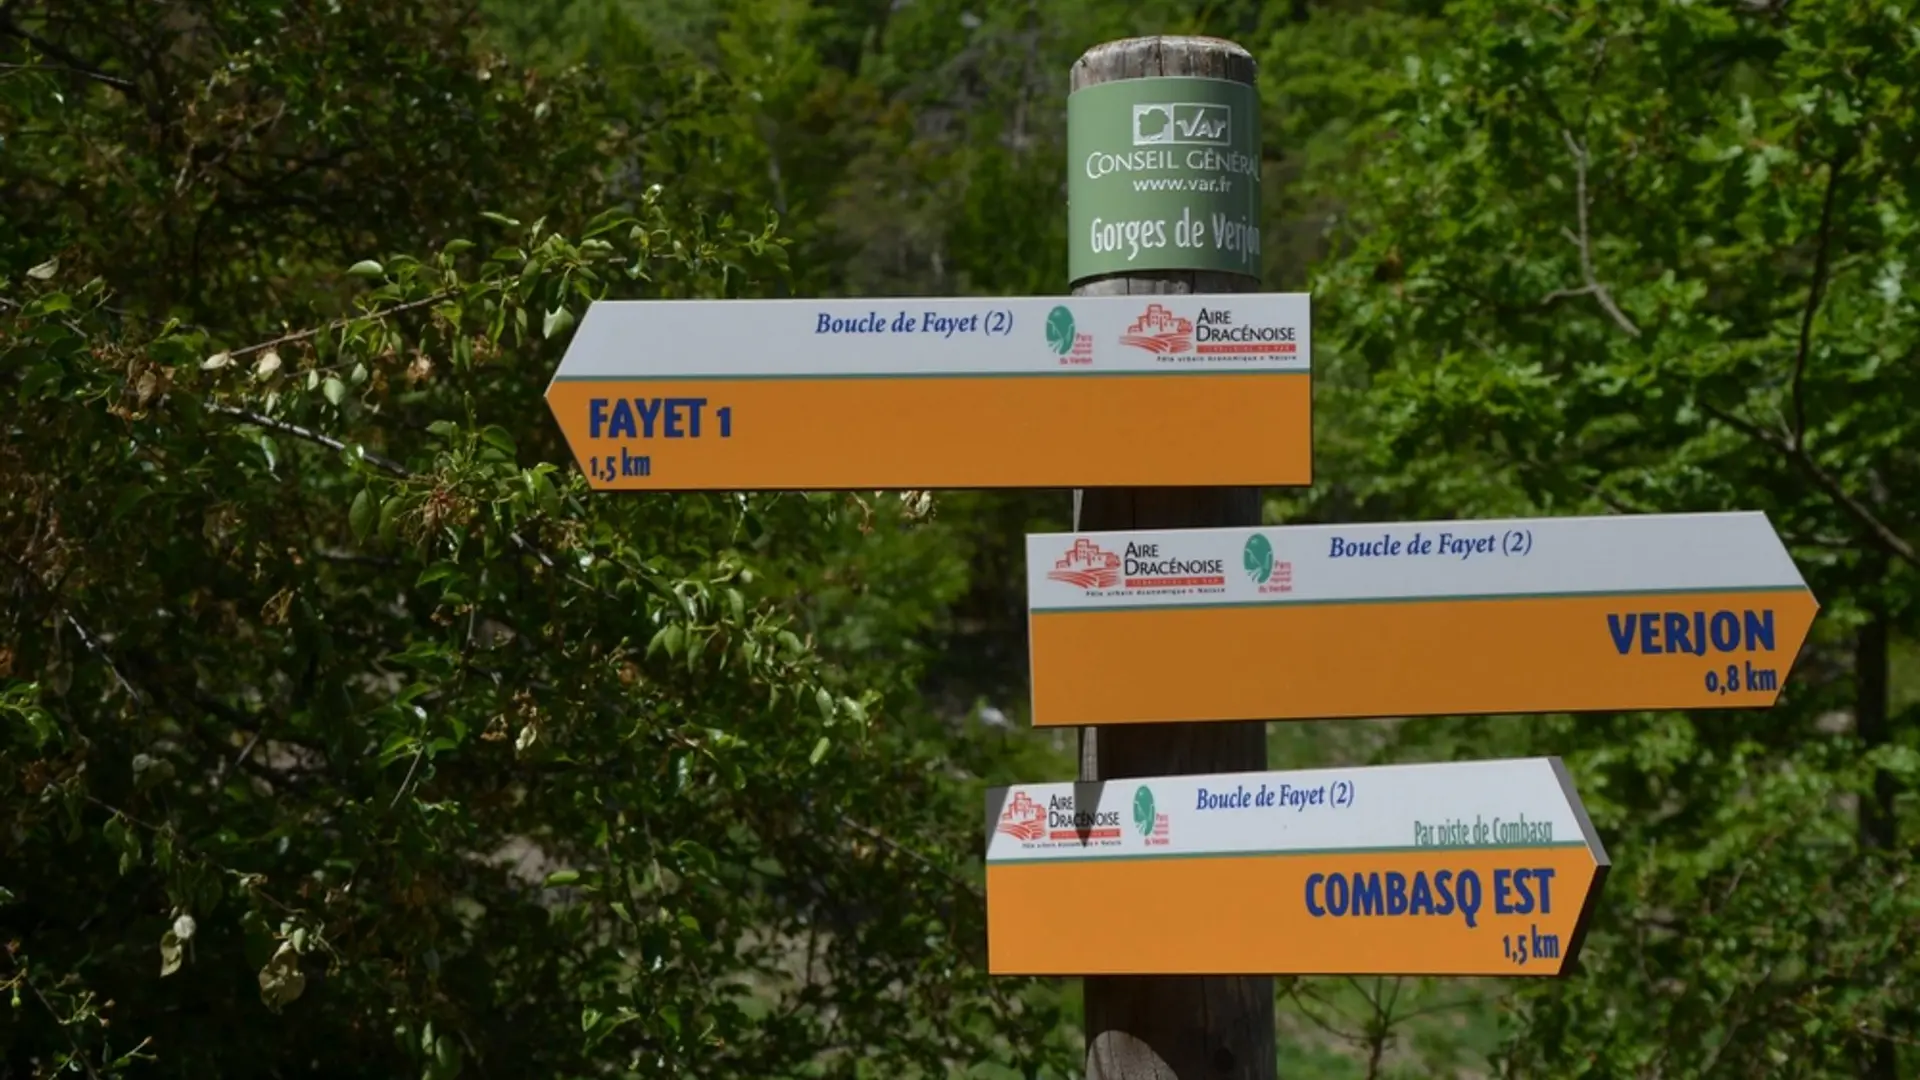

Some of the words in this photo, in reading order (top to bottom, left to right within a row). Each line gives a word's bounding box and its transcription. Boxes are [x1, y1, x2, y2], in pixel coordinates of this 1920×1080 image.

[1086, 150, 1179, 179] CONSEIL
[1133, 176, 1232, 192] www.var.fr
[1091, 218, 1166, 261] Gorges
[1175, 206, 1205, 248] de
[815, 311, 886, 334] Boucle
[891, 311, 916, 333] de
[921, 311, 978, 338] Fayet
[984, 310, 1014, 335] (2)
[1196, 307, 1231, 325] AIRE
[1196, 323, 1296, 342] DRACÉNOISE
[589, 398, 707, 438] FAYET
[716, 406, 731, 438] 1
[590, 456, 616, 482] 1,5
[622, 447, 651, 476] km
[1124, 541, 1159, 558] AIRE
[1329, 534, 1401, 558] Boucle
[1407, 533, 1432, 555] de
[1437, 532, 1496, 560] Fayet
[1503, 529, 1533, 557] (2)
[1124, 556, 1223, 576] DRACÉNOISE
[1607, 610, 1775, 657] VERJON
[1705, 664, 1740, 695] 0,8
[1745, 660, 1777, 692] km
[1049, 793, 1074, 810] AIRE
[1196, 785, 1251, 810] Boucle
[1255, 784, 1275, 807] de
[1279, 784, 1326, 812] Fayet
[1330, 780, 1355, 808] (2)
[1414, 820, 1434, 846] Par
[1437, 818, 1469, 846] piste
[1473, 814, 1489, 844] de
[1304, 869, 1482, 928] COMBASQ
[1493, 868, 1555, 915] EST
[1503, 934, 1527, 965] 1,5
[1531, 924, 1559, 958] km
